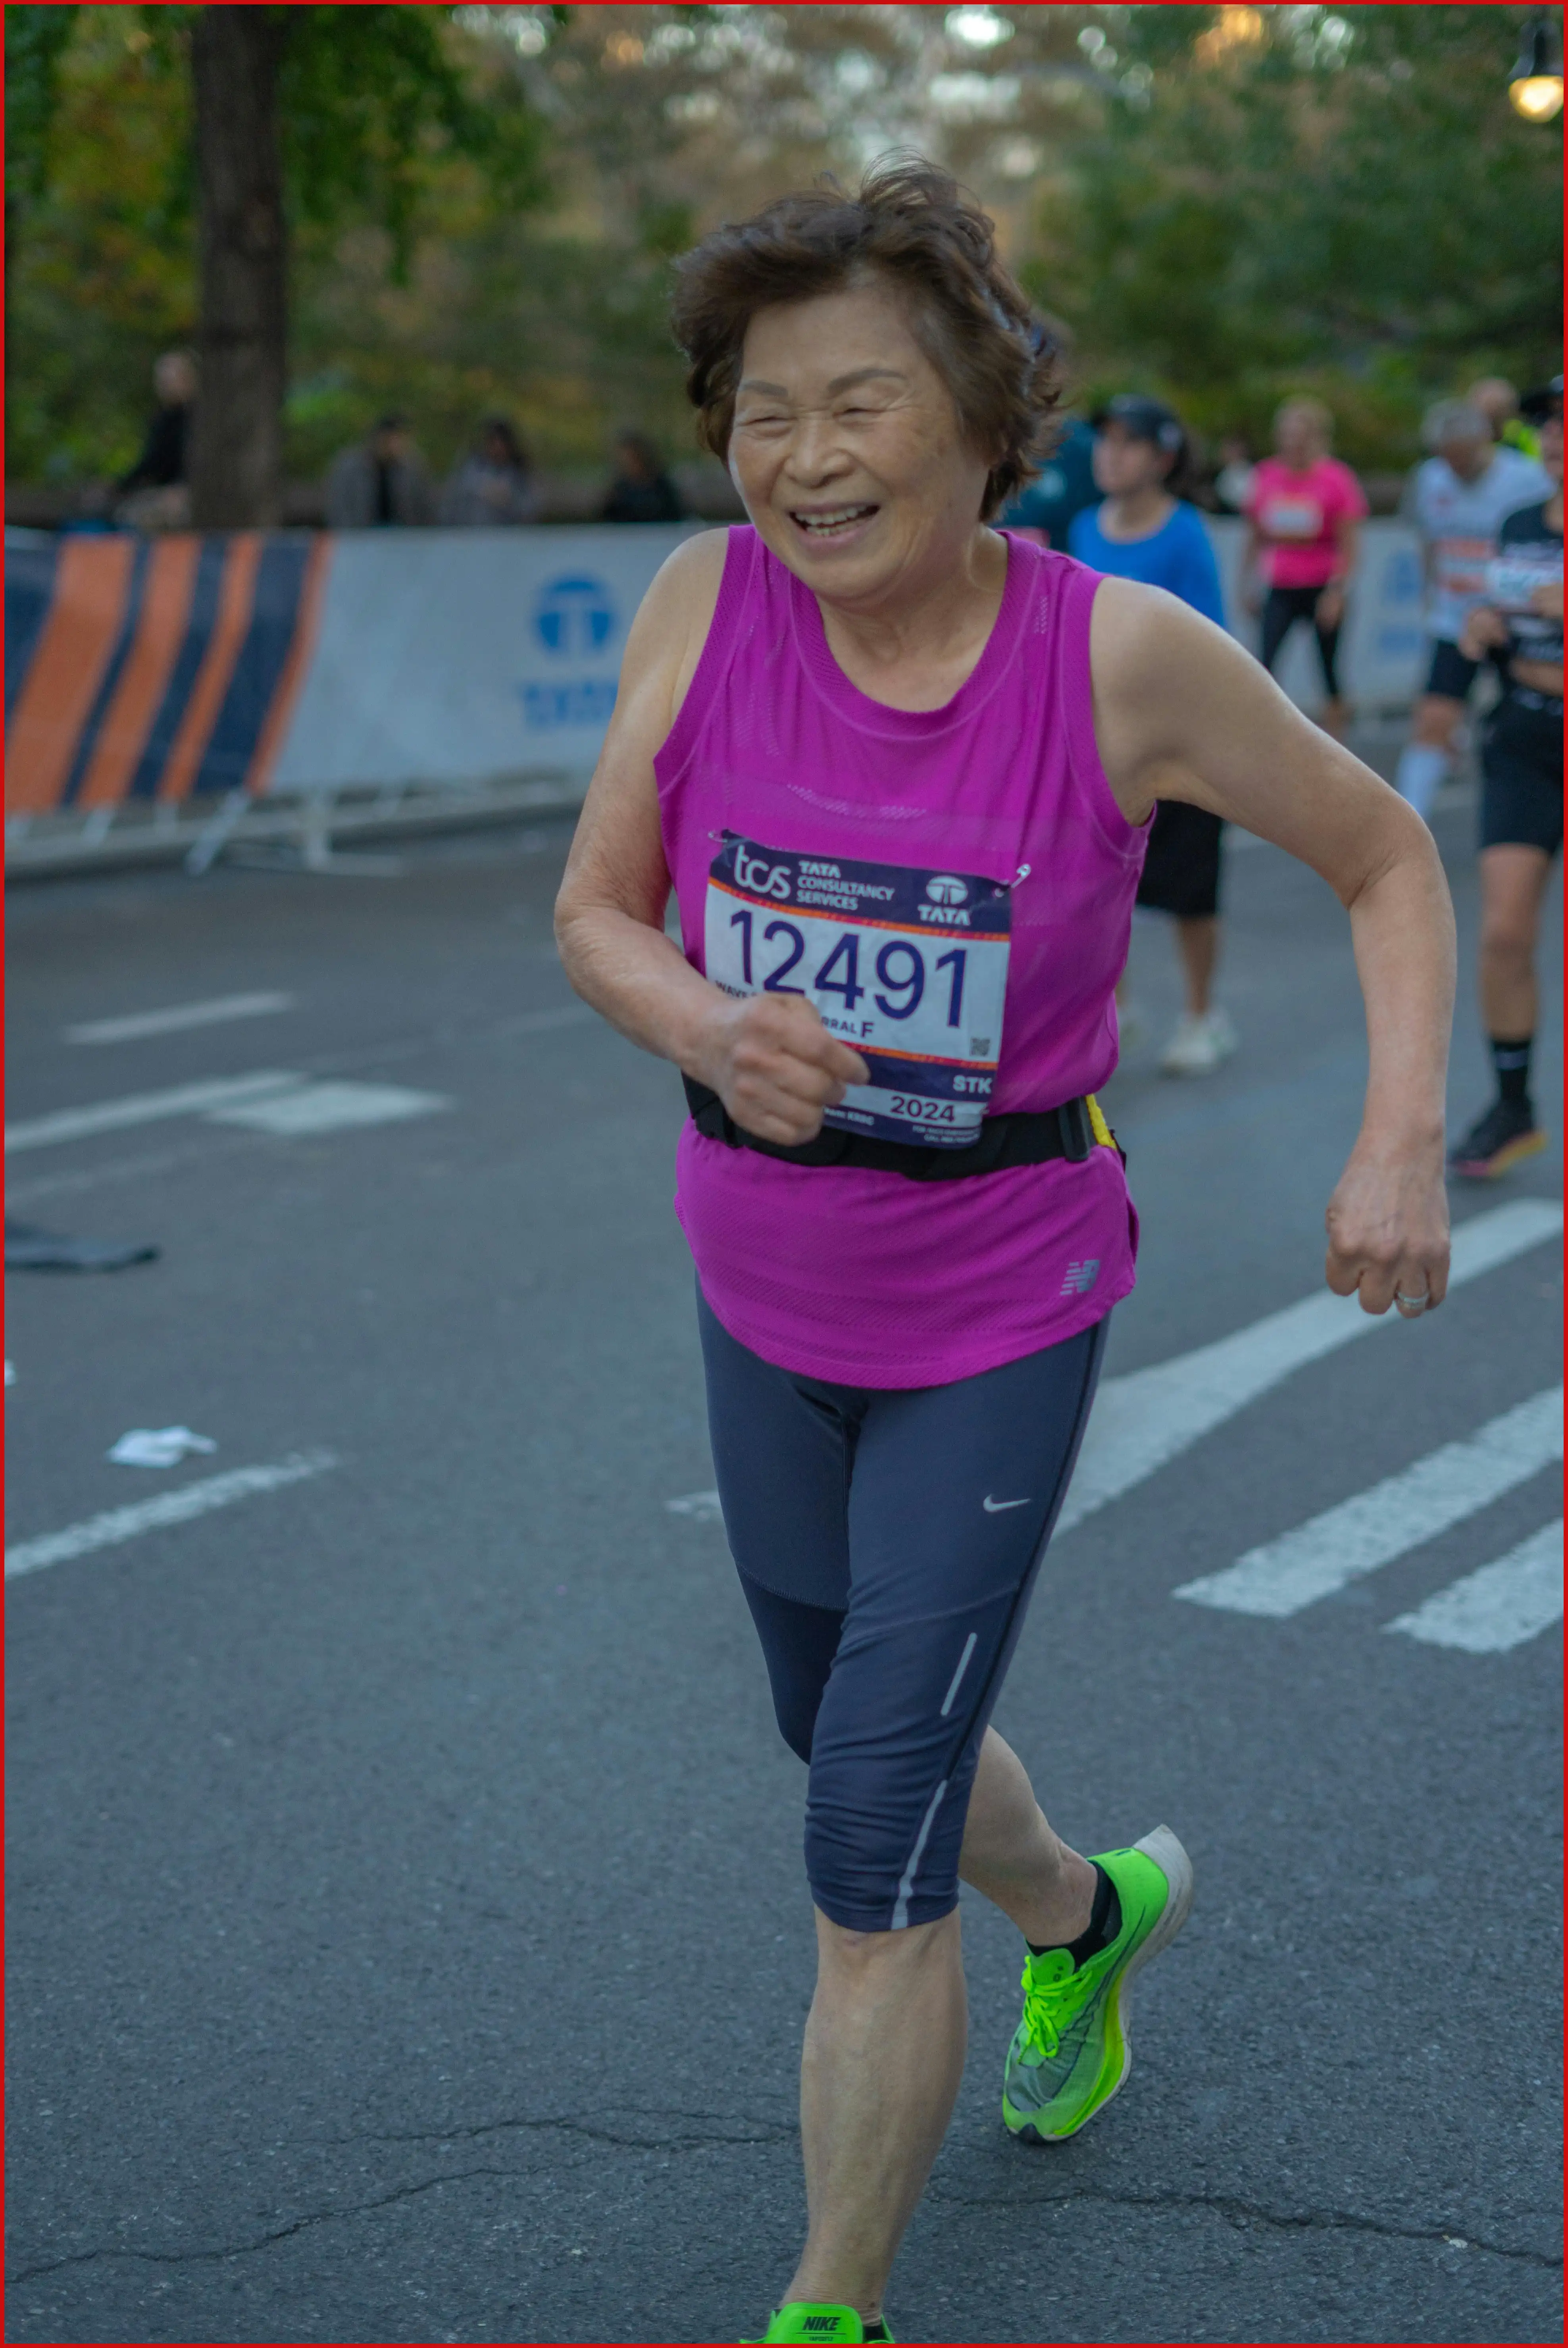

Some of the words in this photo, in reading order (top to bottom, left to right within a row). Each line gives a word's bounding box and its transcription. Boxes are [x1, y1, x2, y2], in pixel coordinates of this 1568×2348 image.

[734, 844, 791, 899] tcs
[798, 860, 841, 879] TATA
[797, 875, 895, 901] CONSULTANCY
[796, 889, 859, 911] SERVICES
[917, 904, 971, 926] TATA
[730, 909, 968, 1029] 12491
[821, 1016, 858, 1035] RRAL
[861, 1020, 875, 1038] F
[953, 1075, 992, 1094] STK
[890, 1095, 955, 1122] 2024
[802, 2316, 841, 2331] NIKE
